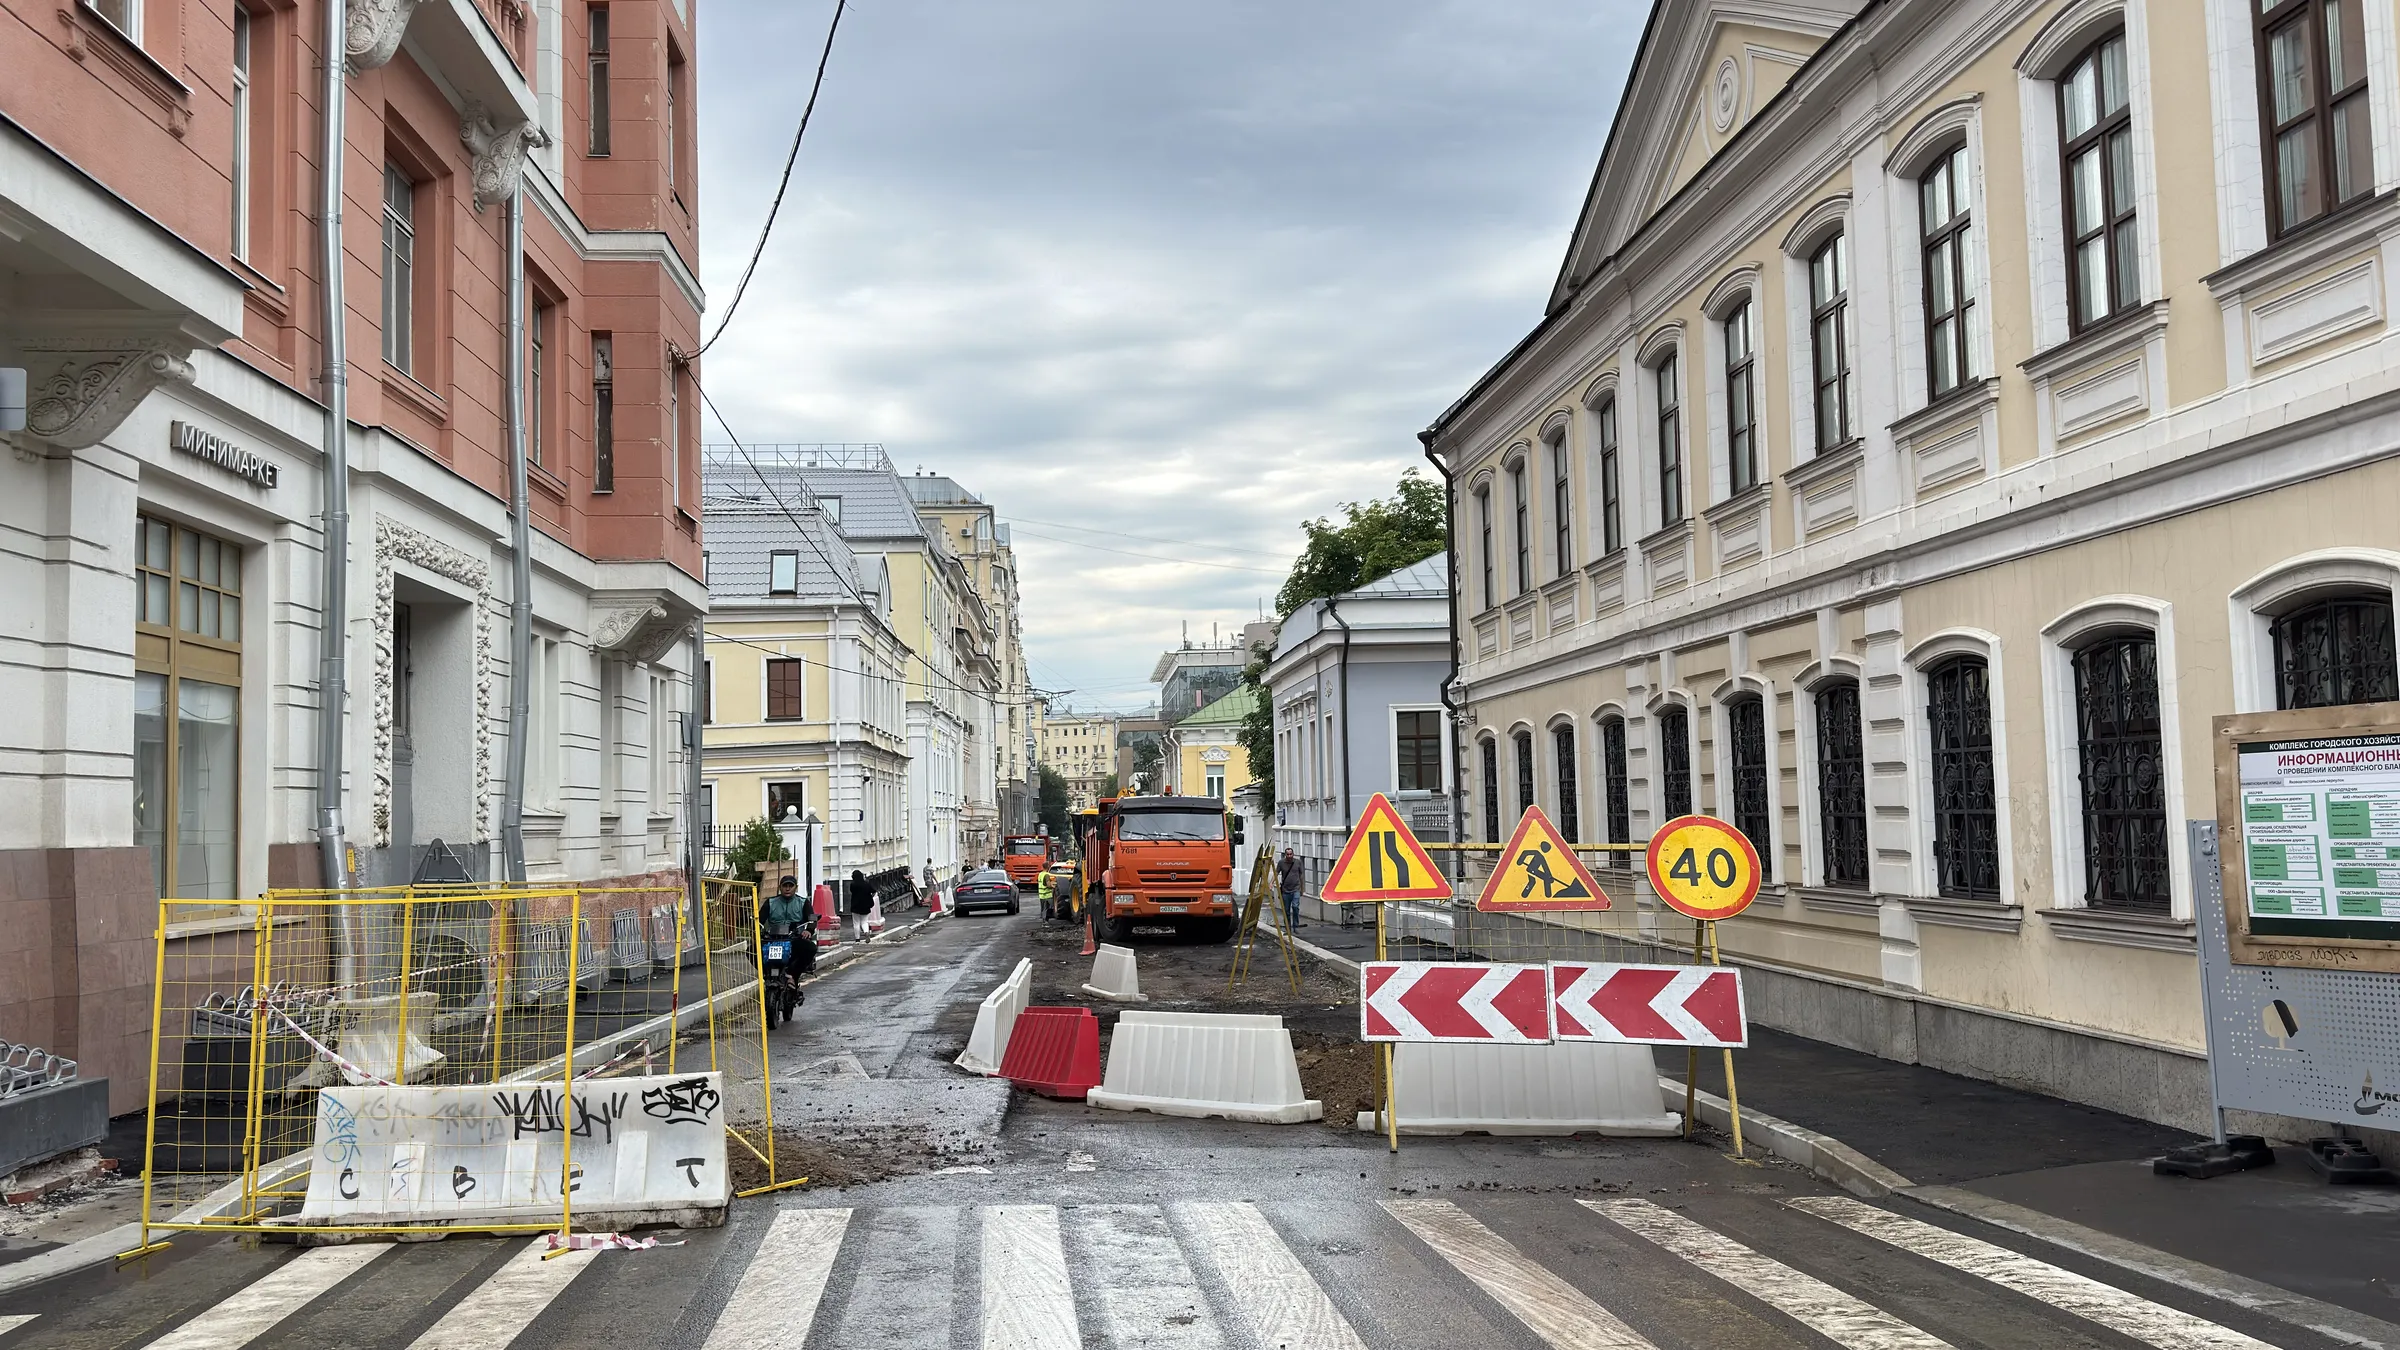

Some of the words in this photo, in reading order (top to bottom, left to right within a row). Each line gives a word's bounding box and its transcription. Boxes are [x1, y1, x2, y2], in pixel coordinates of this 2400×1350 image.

[181, 422, 282, 489] МИНИМАРКЕТ
[2269, 740, 2309, 751] КОМПЛЕКС
[2310, 737, 2362, 749] ГОРОДСКОГО
[2283, 767, 2327, 775] ПРОВЕДЕНИИ
[2328, 764, 2383, 773] КОМПЛЕКСНОГО
[2384, 763, 2400, 771] БЛА
[1669, 847, 1737, 889] 40
